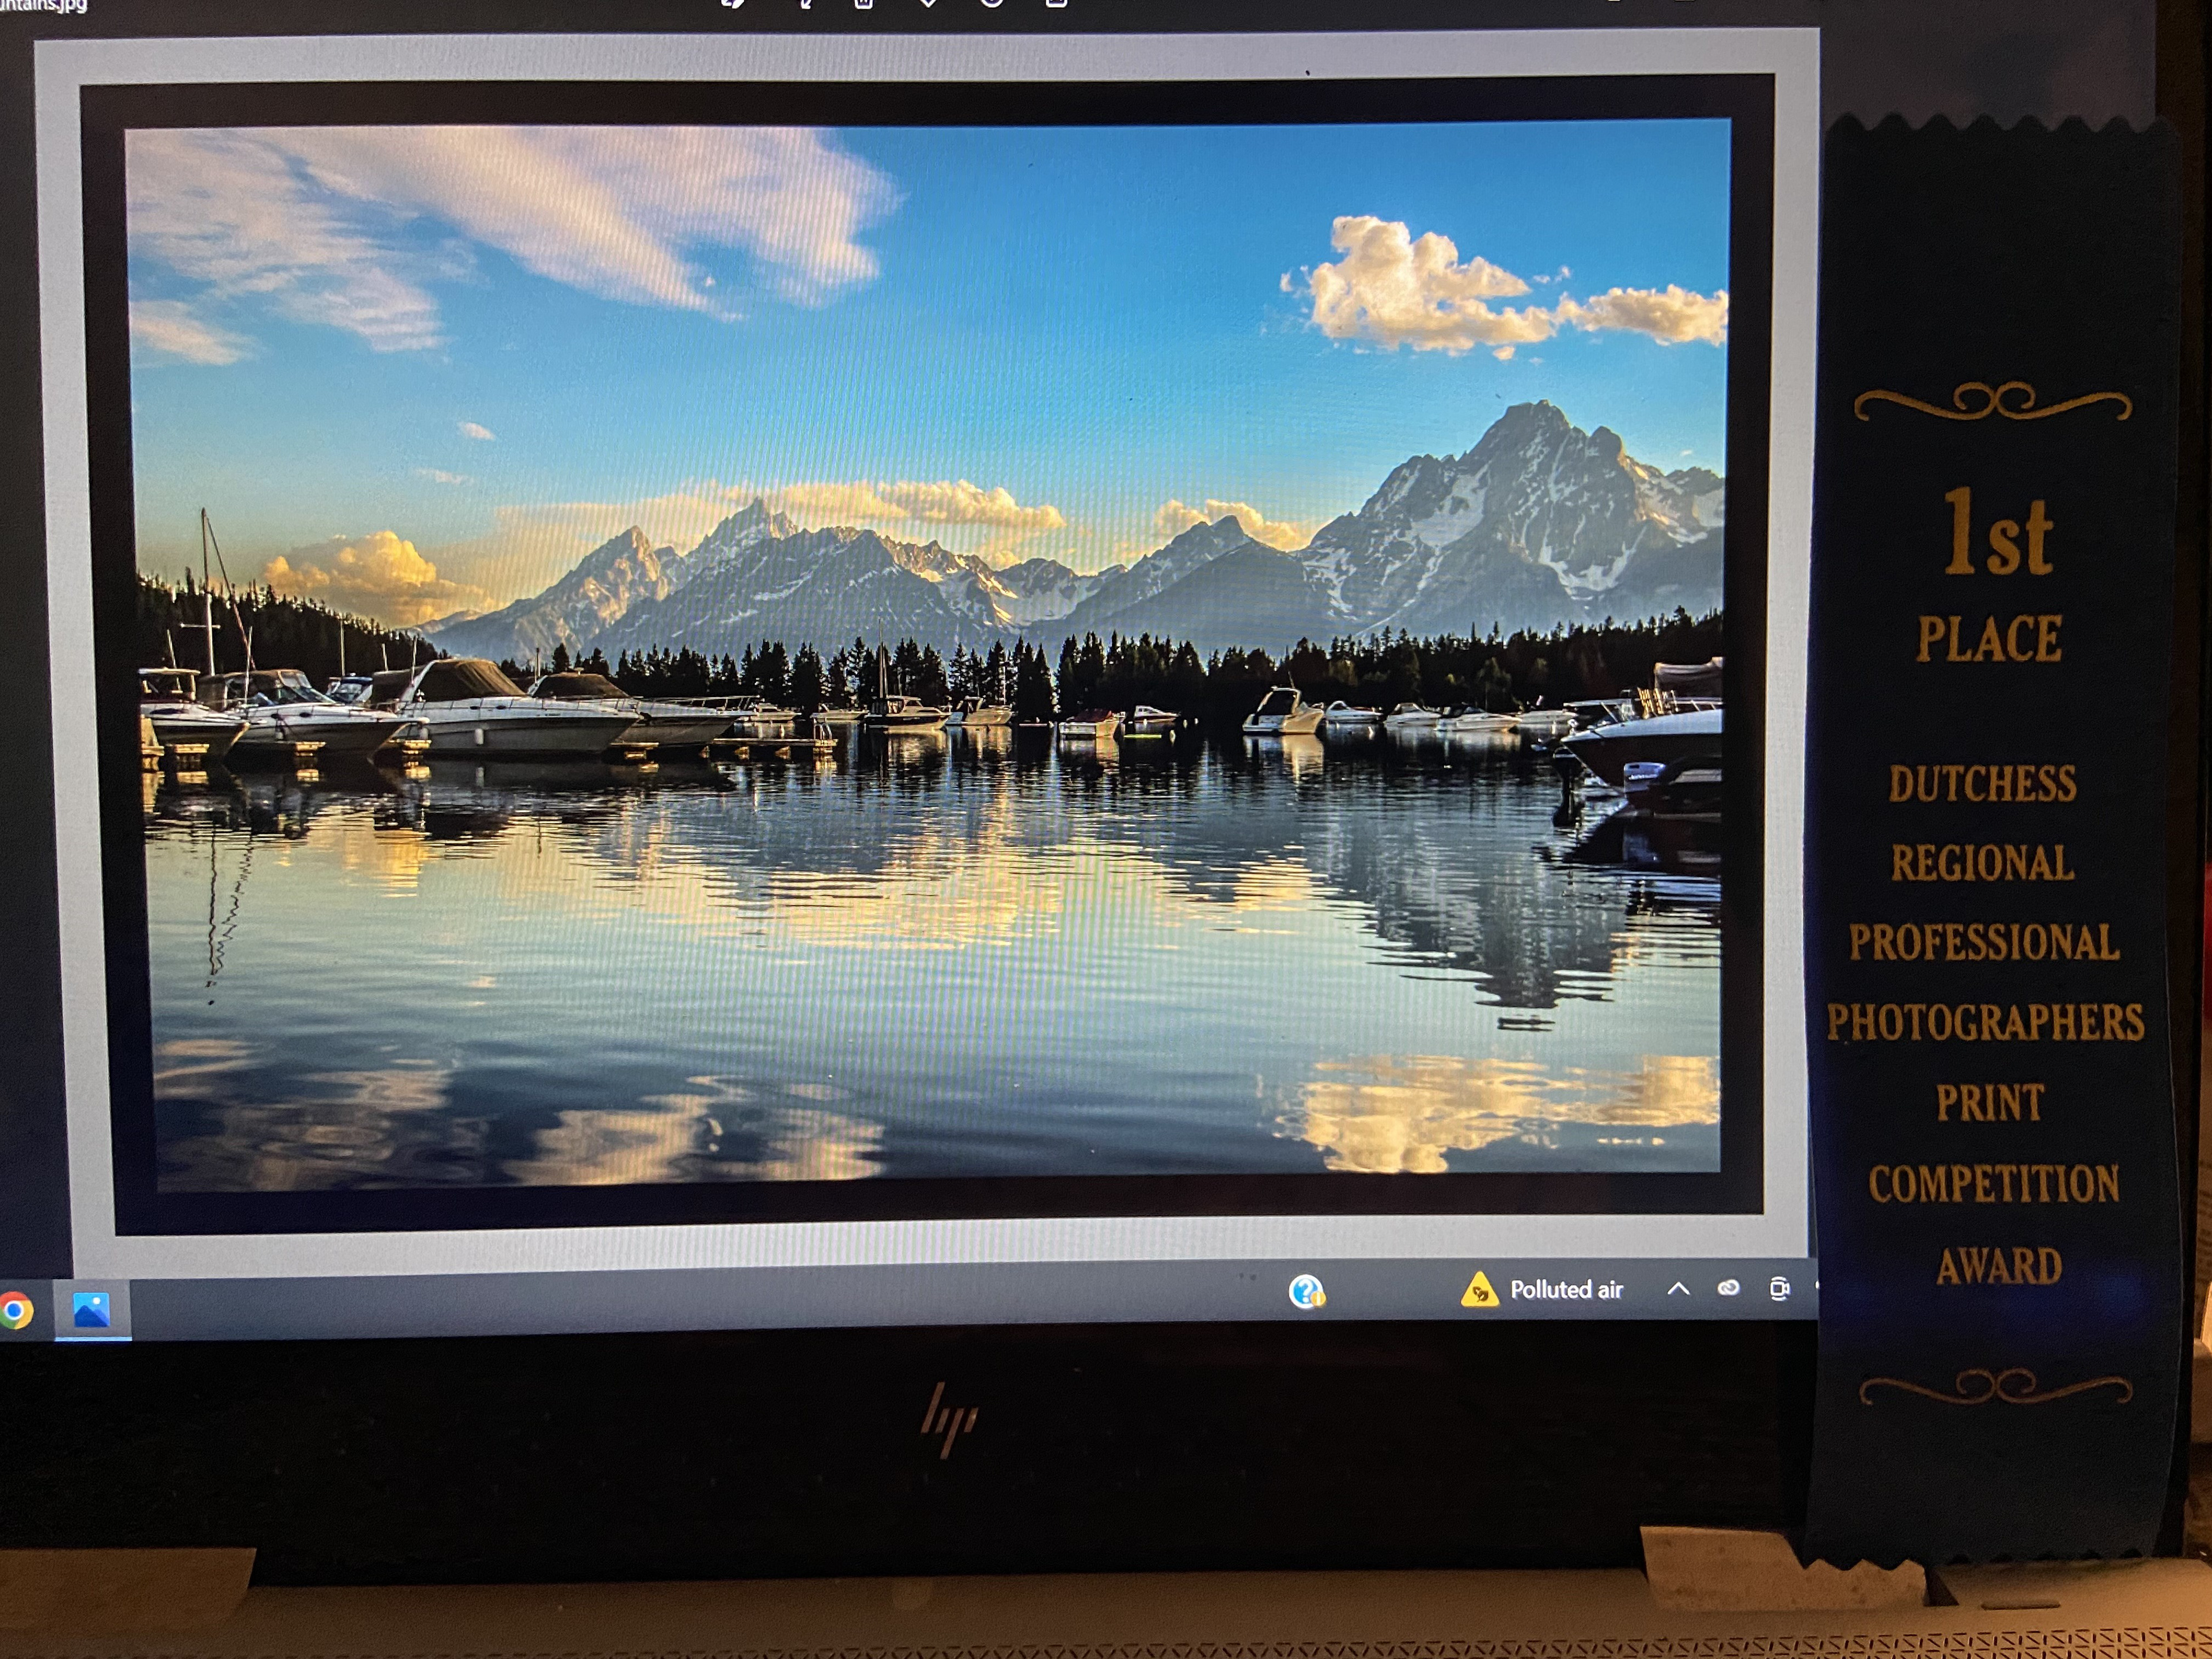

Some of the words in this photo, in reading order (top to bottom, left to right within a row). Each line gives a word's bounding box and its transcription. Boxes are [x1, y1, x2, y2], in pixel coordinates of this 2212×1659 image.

[1945, 486, 2054, 575] 1st
[1916, 615, 2062, 662] PLACE
[1889, 764, 2077, 802] DUTCHESS
[1892, 844, 2075, 881] REGIONAL
[1850, 923, 2120, 960] PROFESSIONAL
[1828, 1003, 2145, 1041] PHOTOGRAPHERS
[1937, 1083, 2046, 1121] PRINT
[1869, 1164, 2119, 1203] COMPETITION
[1937, 1247, 2062, 1285] AWARD
[1511, 1278, 1593, 1300] Polluted
[1597, 1279, 1624, 1300] air
